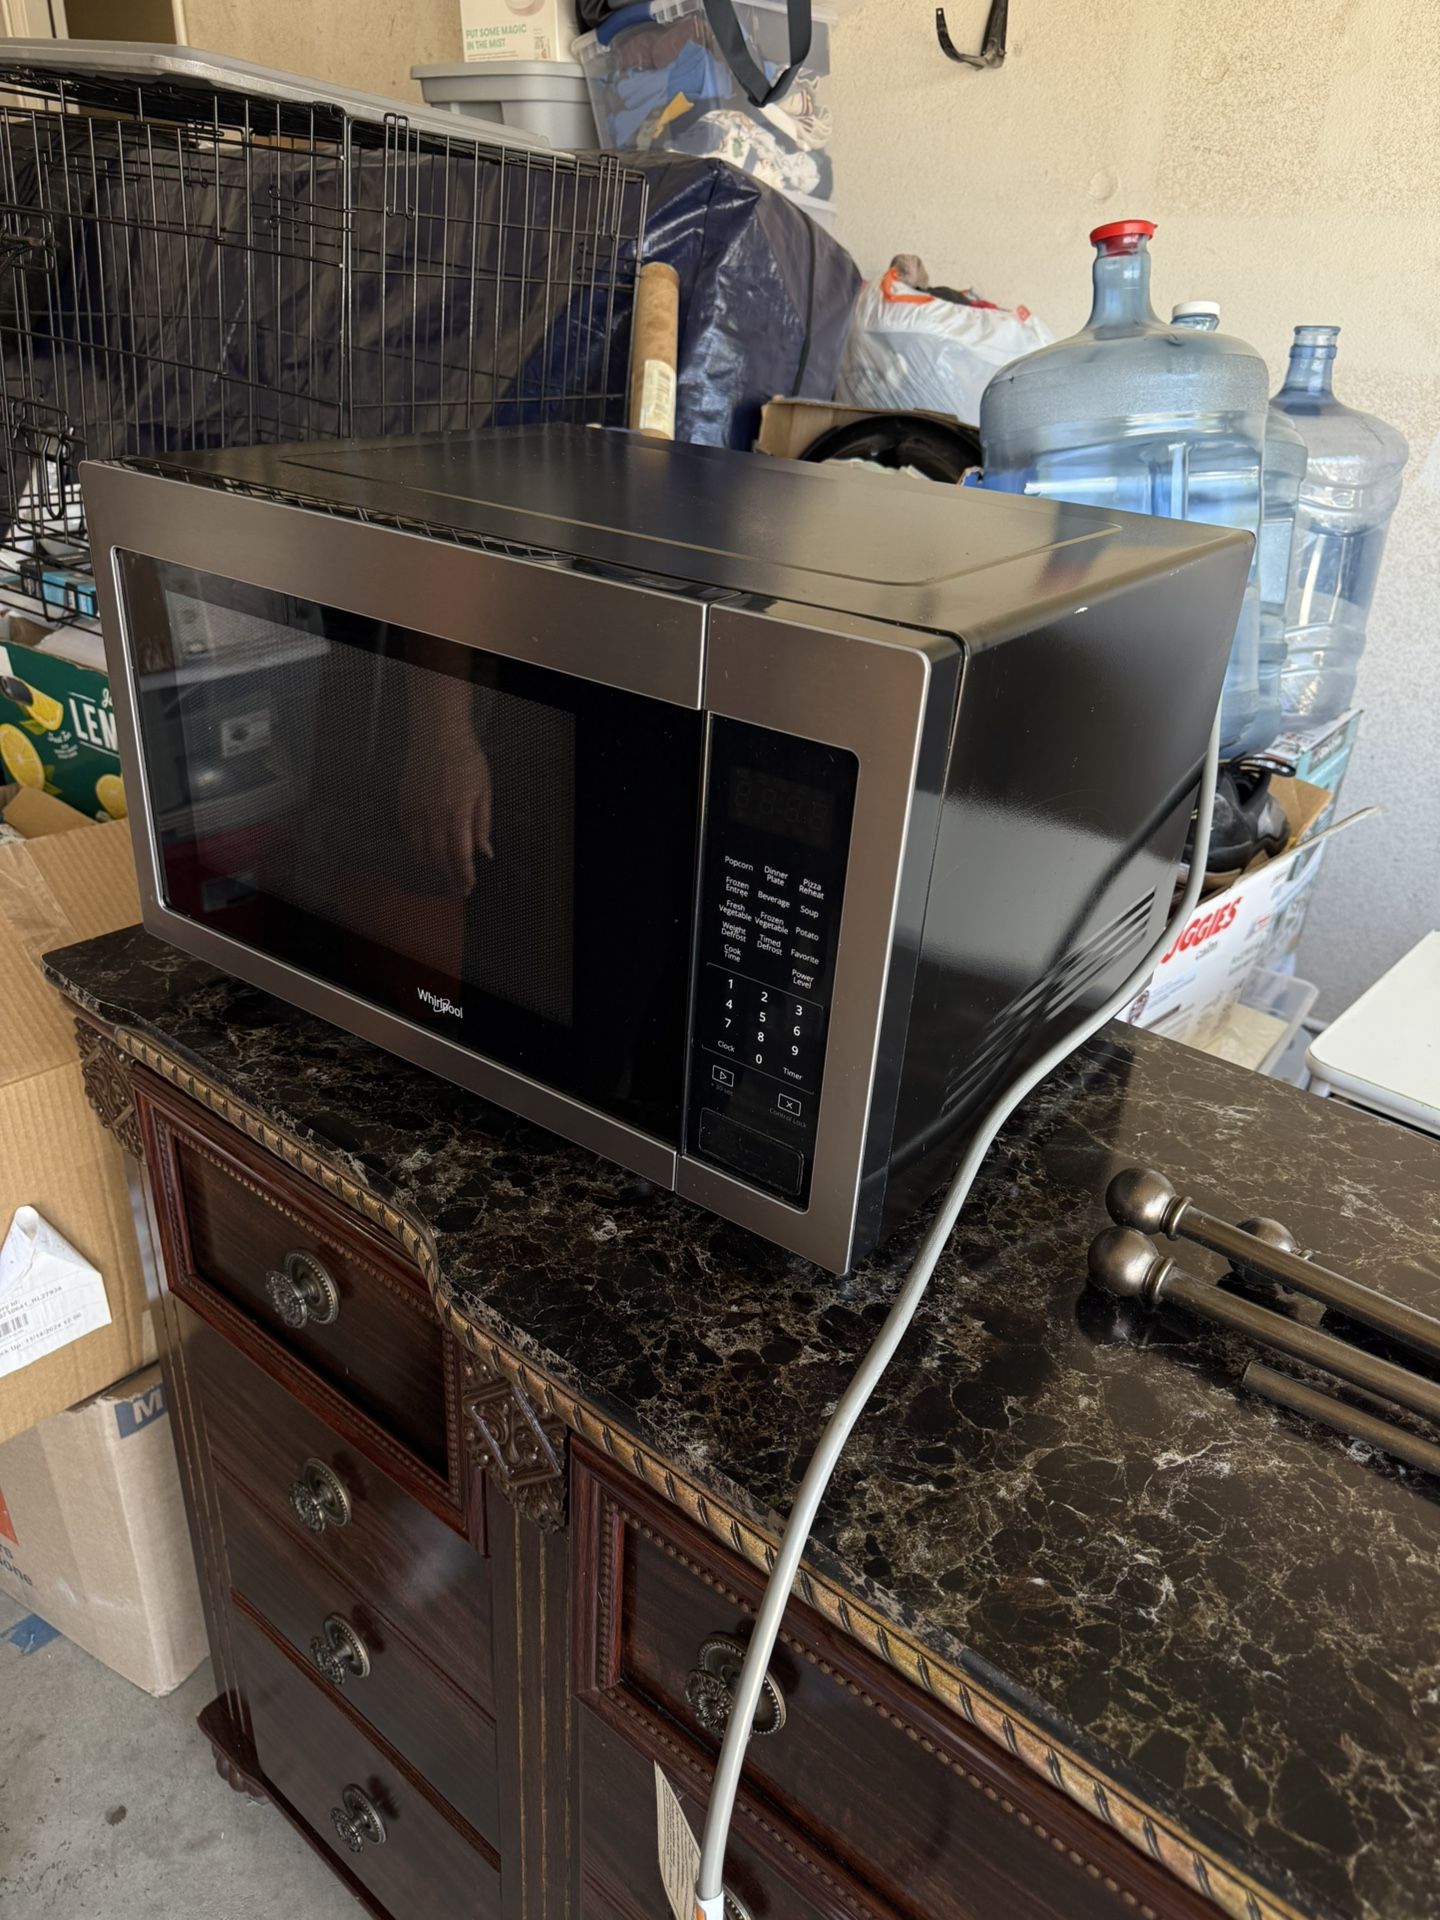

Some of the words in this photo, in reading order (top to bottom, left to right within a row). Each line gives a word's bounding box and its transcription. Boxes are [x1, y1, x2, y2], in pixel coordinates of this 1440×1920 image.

[466, 29, 478, 38] PUT
[480, 27, 499, 37] SOME
[502, 24, 526, 35] MAGIC
[467, 41, 474, 50] IN
[476, 40, 488, 49] THE
[725, 856, 753, 871] Popcorn
[764, 866, 788, 880] Dinner
[726, 876, 749, 889] Frozen
[767, 874, 784, 886] Plate
[803, 879, 821, 891] Pizza
[799, 885, 824, 900] Reheat
[726, 900, 745, 912] Fresh
[758, 891, 790, 908] Beverage
[719, 904, 752, 922] Vegetable
[761, 912, 784, 925] Frozen
[800, 906, 819, 918] Soup
[722, 921, 746, 935] Weight
[755, 916, 788, 935] Vegetable
[721, 928, 746, 943] Defrost
[760, 934, 781, 947] Timed
[795, 927, 819, 941] Potato
[724, 944, 741, 955] Cook
[757, 941, 782, 955] Defrost
[724, 951, 740, 962] Time
[791, 949, 819, 965] Favorite
[792, 969, 814, 982] Power
[728, 979, 734, 989] 1
[793, 977, 811, 989] Level
[417, 987, 463, 1019] Whirlpool
[760, 992, 768, 1002] 2
[726, 999, 733, 1009] 4
[795, 1005, 803, 1016] 3
[724, 1018, 732, 1028] 7
[759, 1012, 766, 1022] 5
[794, 1025, 801, 1036] 6
[757, 1032, 765, 1043] 8
[718, 1040, 735, 1053] Clock
[792, 1045, 799, 1056] 9
[756, 1054, 762, 1064] 0
[783, 1067, 803, 1081] Timer
[770, 1108, 792, 1123] Control
[793, 1116, 807, 1129] Lock
